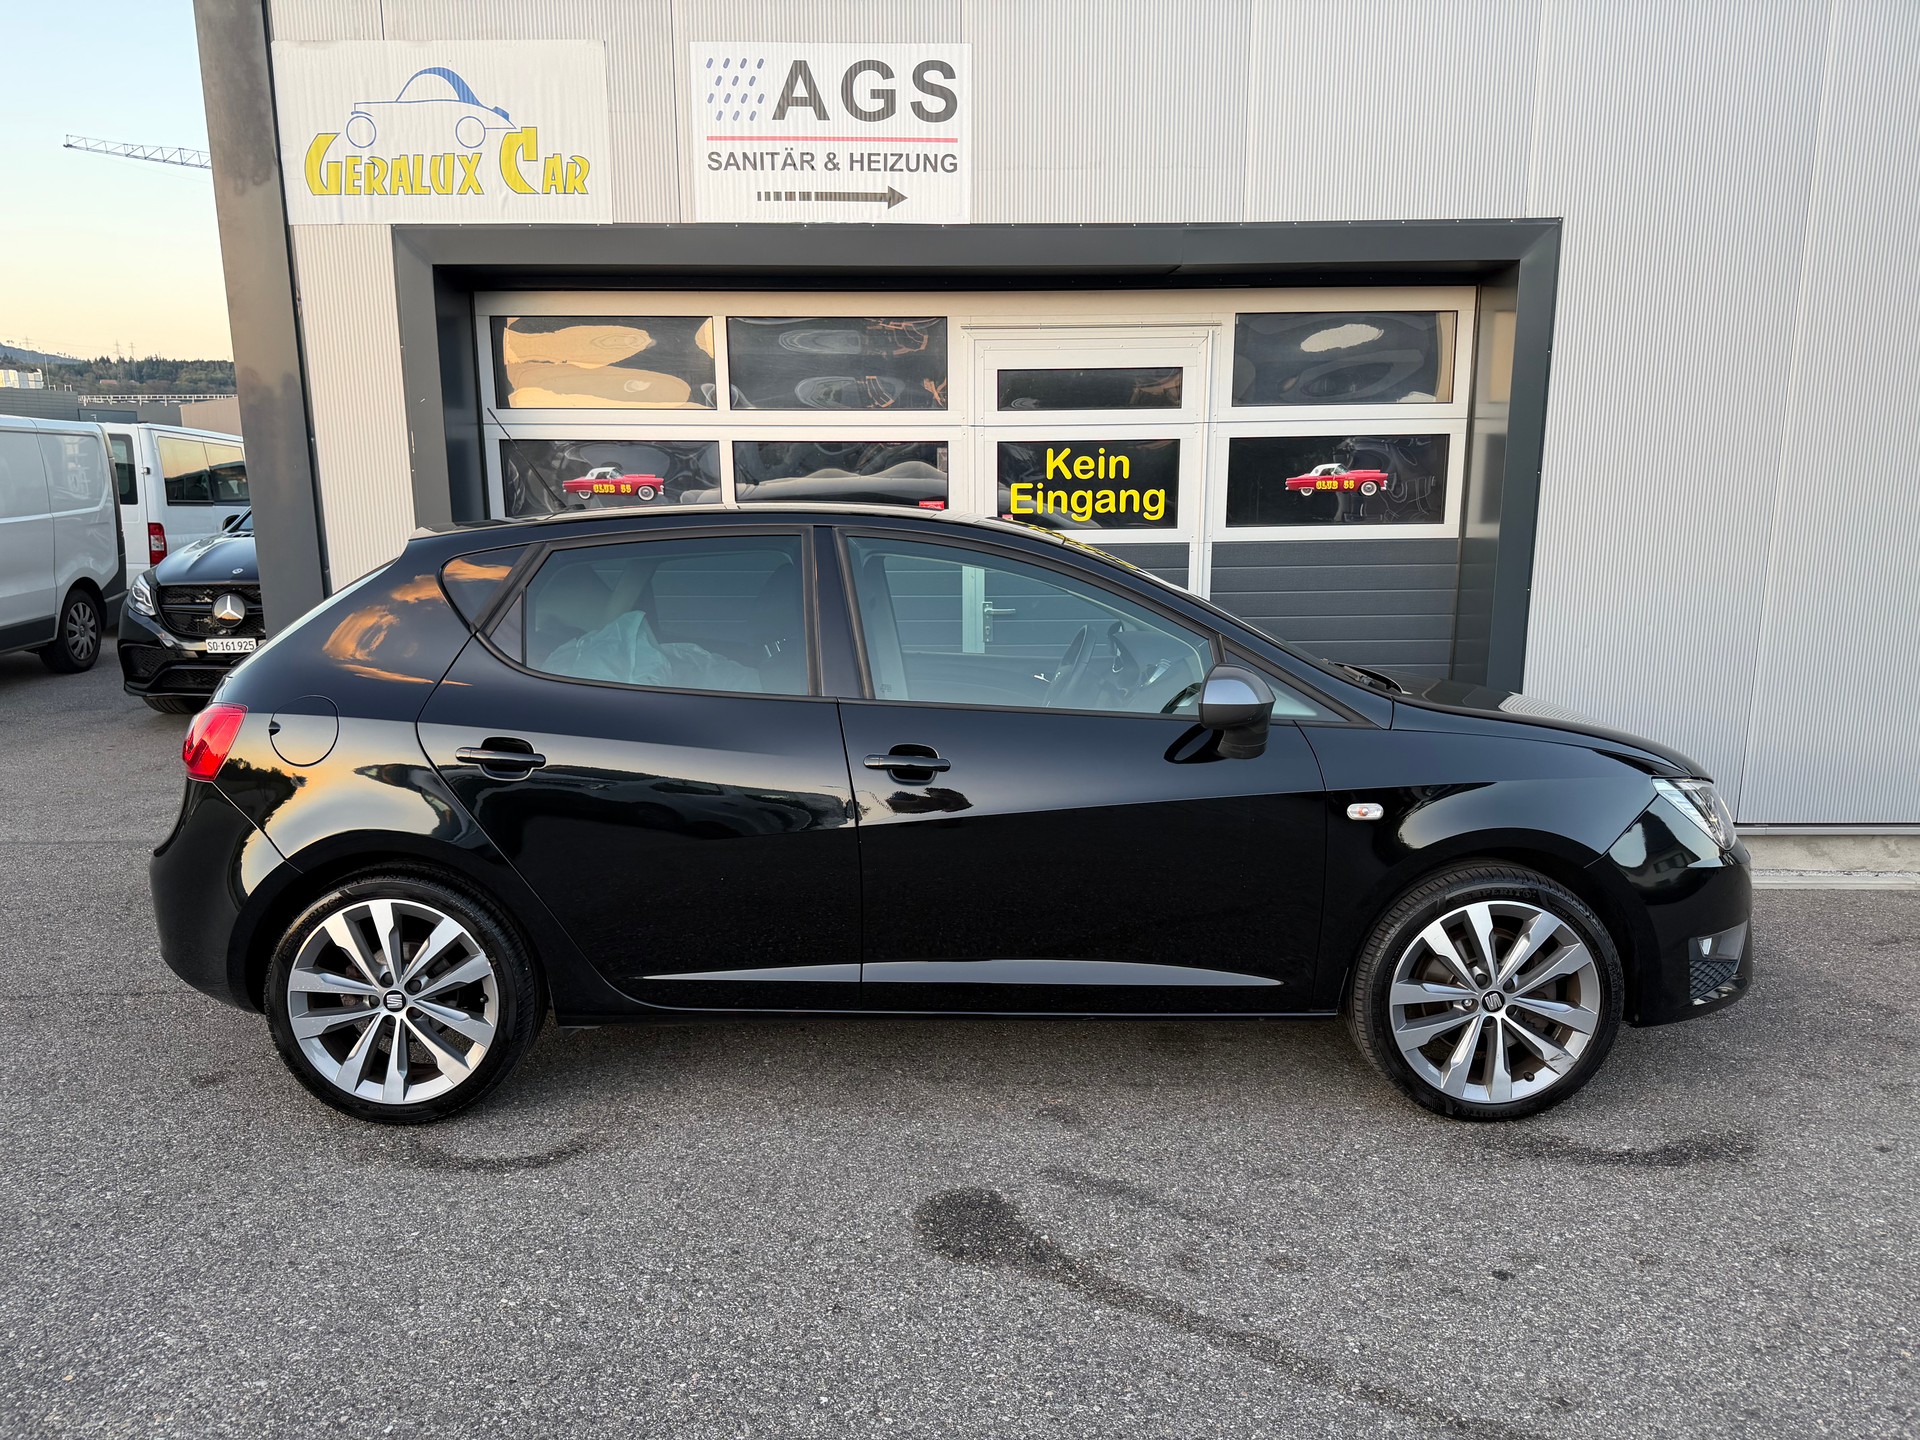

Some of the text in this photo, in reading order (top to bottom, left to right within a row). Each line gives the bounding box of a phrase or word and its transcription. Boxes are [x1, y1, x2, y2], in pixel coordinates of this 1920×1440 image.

[771, 59, 958, 122] AGS
[305, 126, 590, 195] GERALUX CAR
[707, 147, 958, 173] SANITÄR & HEIZUNG
[1046, 447, 1130, 480] Kein
[593, 484, 615, 494] CLUB
[1316, 480, 1354, 490] CLUB 55
[1010, 482, 1165, 522] Eingang
